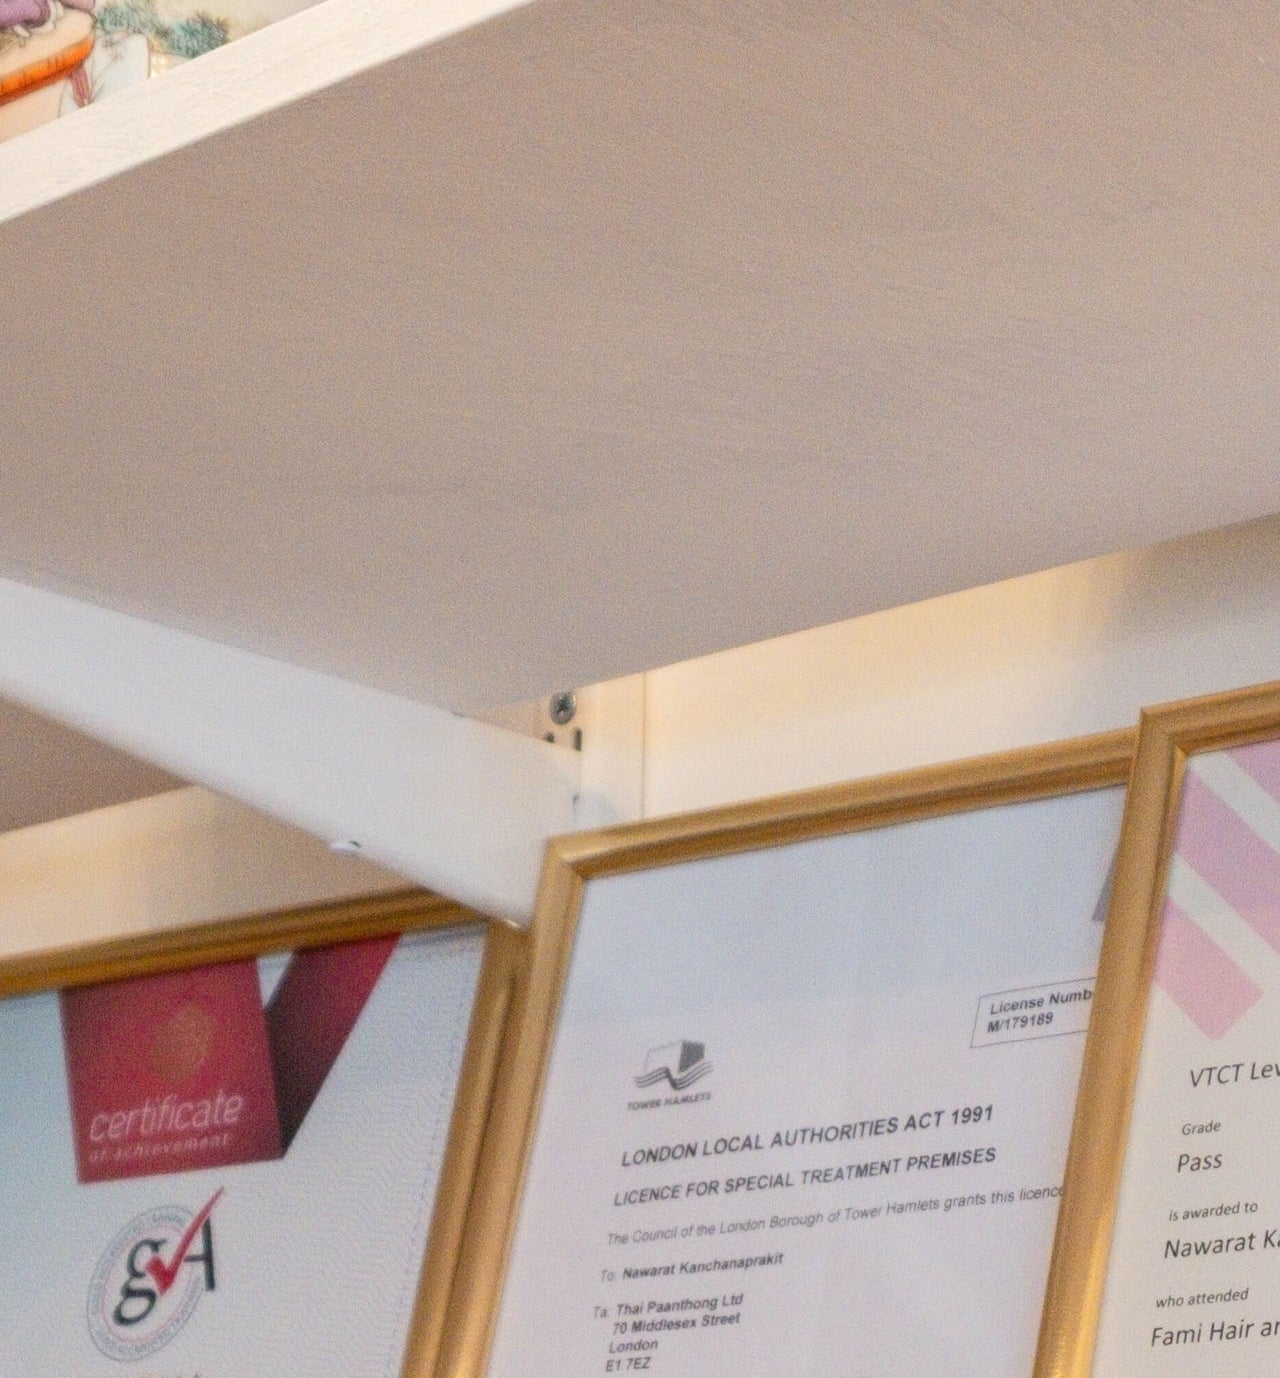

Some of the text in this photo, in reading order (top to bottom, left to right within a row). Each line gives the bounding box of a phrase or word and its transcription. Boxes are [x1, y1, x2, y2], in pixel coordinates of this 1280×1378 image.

[989, 988, 1095, 1015] License Numb
[986, 1011, 1054, 1033] M/179189
[1189, 1061, 1245, 1089] VTCT
[89, 1090, 244, 1141] certificate
[1181, 1119, 1222, 1136] Grade
[621, 1105, 995, 1168] LONDON LOCAL AUTHORITIES ACT 1991
[1176, 1150, 1224, 1174] Pass
[614, 1146, 997, 1207] LICENCE FOR SPECIAL TREATMENT PREMISES
[607, 1189, 1015, 1246] The Council the London Borough of Tower Hamlets grants this
[1183, 1201, 1259, 1220] awarded to
[1164, 1233, 1255, 1260] Nawarat
[622, 1251, 785, 1280] Nawarat Kanchanaprakit
[616, 1292, 743, 1317] Thai Paanthong Ltd
[1156, 1286, 1250, 1310] who attended
[612, 1312, 741, 1335] 70 Middlesex Street
[1150, 1322, 1203, 1347] Fami
[1208, 1316, 1254, 1342] Hair
[609, 1338, 658, 1354] London
[606, 1354, 651, 1371] E1 7EZ
